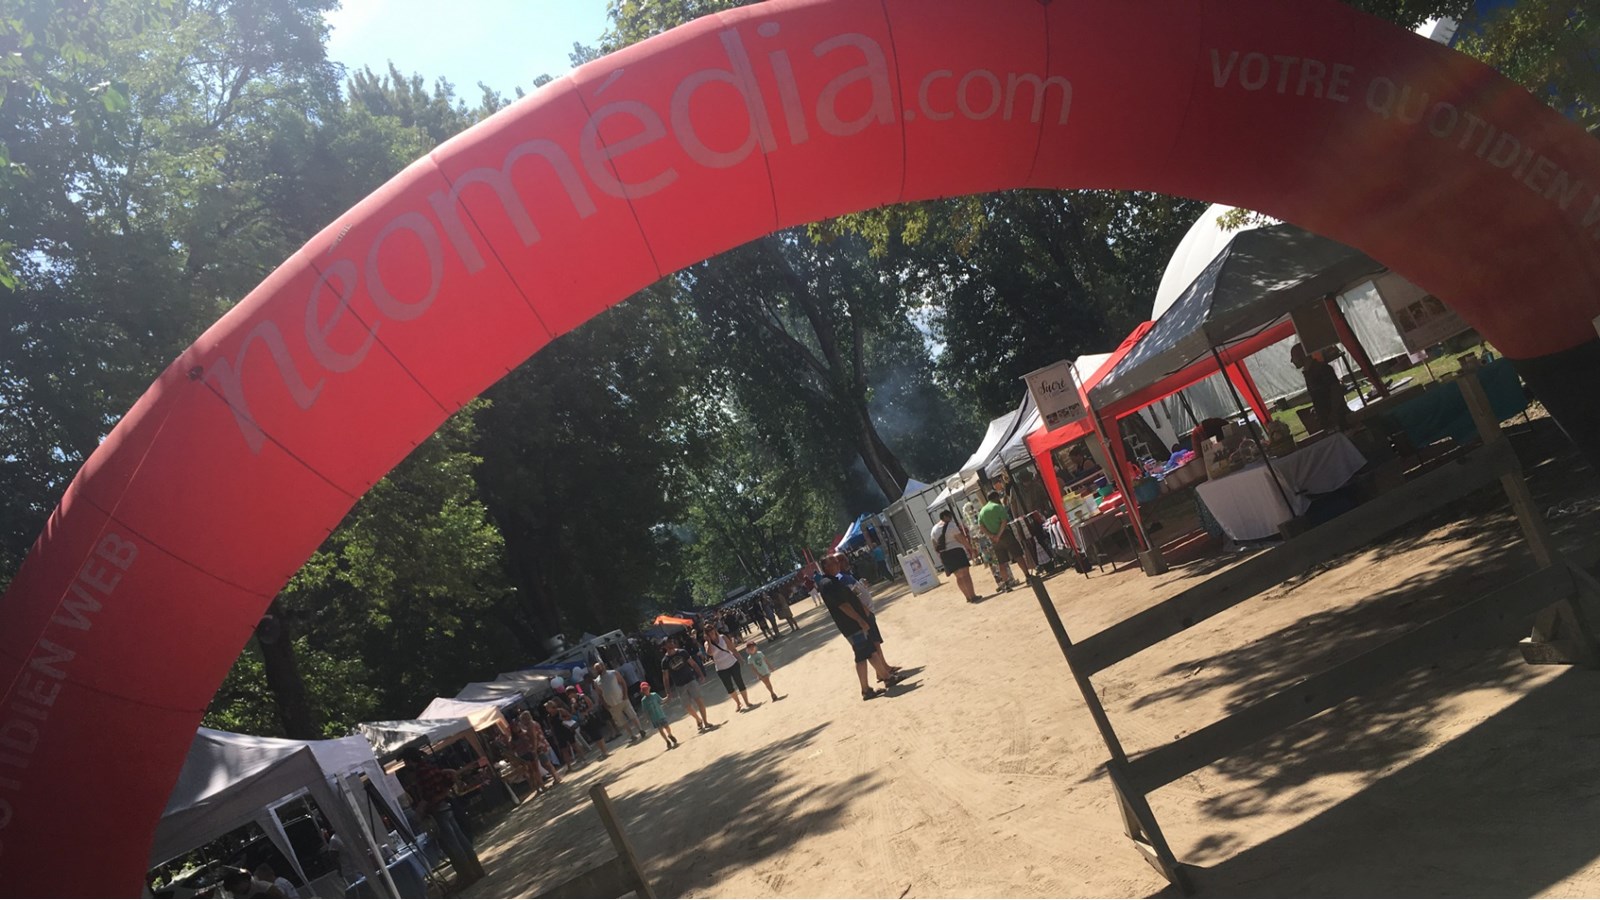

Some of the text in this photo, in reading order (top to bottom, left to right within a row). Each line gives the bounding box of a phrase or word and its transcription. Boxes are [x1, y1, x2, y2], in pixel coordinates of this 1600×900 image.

[1209, 48, 1583, 210] VOTRE QUOTIDIEN
[51, 532, 138, 631] WEB
